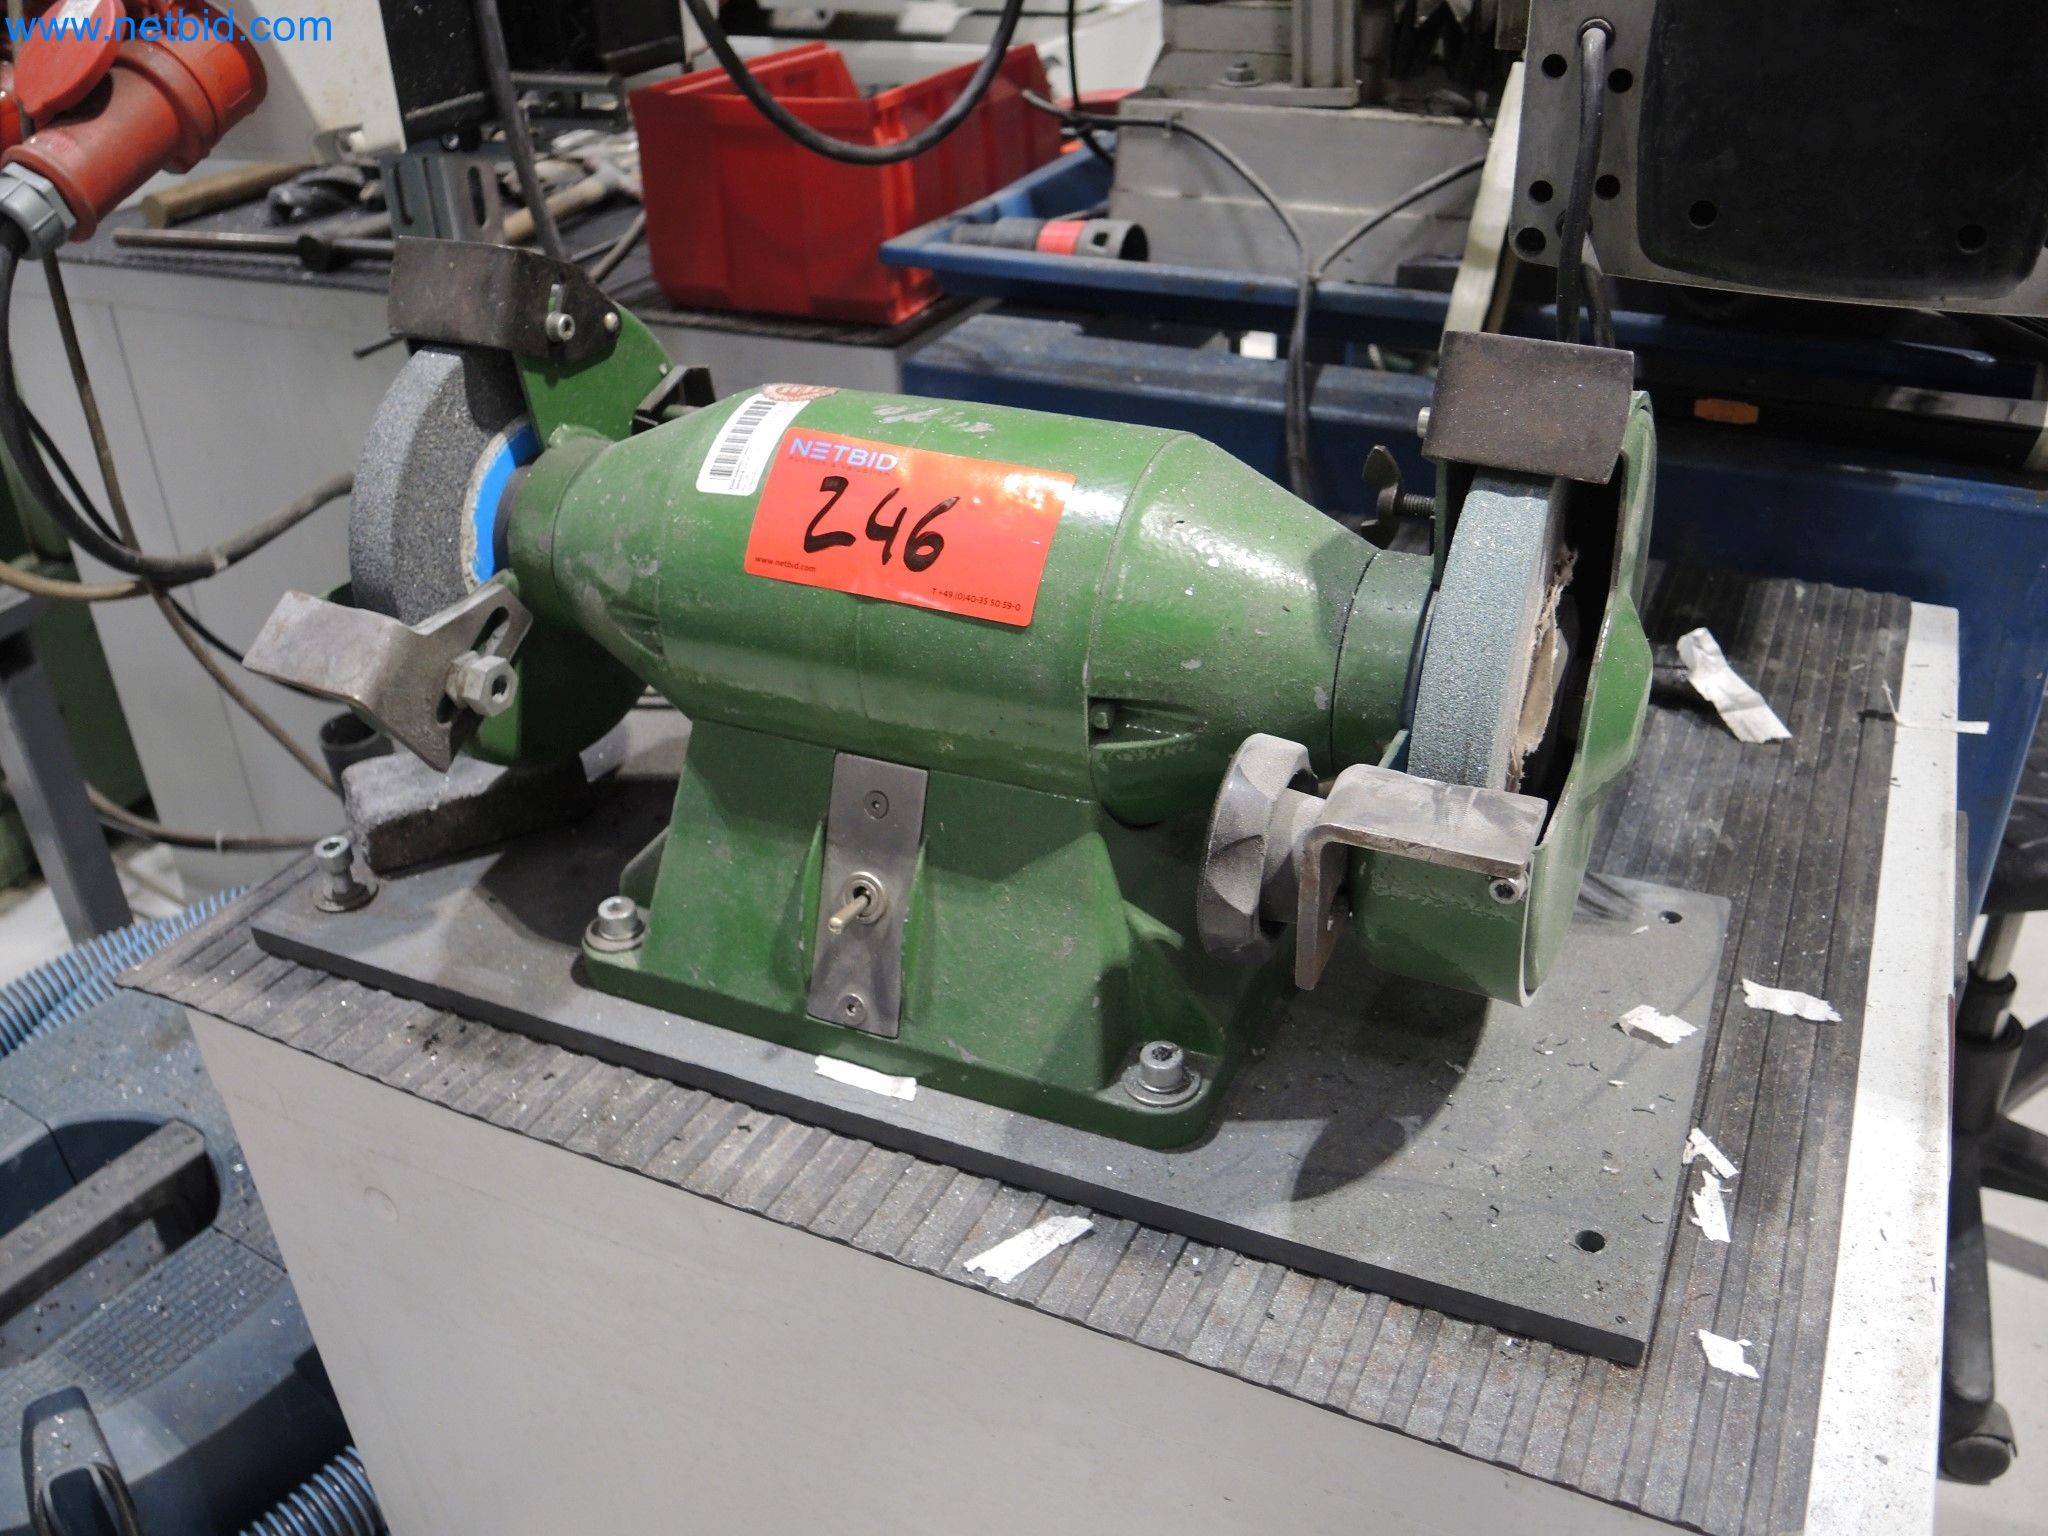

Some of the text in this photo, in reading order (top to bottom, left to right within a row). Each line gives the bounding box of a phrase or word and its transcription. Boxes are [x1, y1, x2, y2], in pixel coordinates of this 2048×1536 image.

[789, 438, 899, 472] NETBID
[803, 475, 961, 573] 246
[754, 556, 817, 573] www.netbid.com
